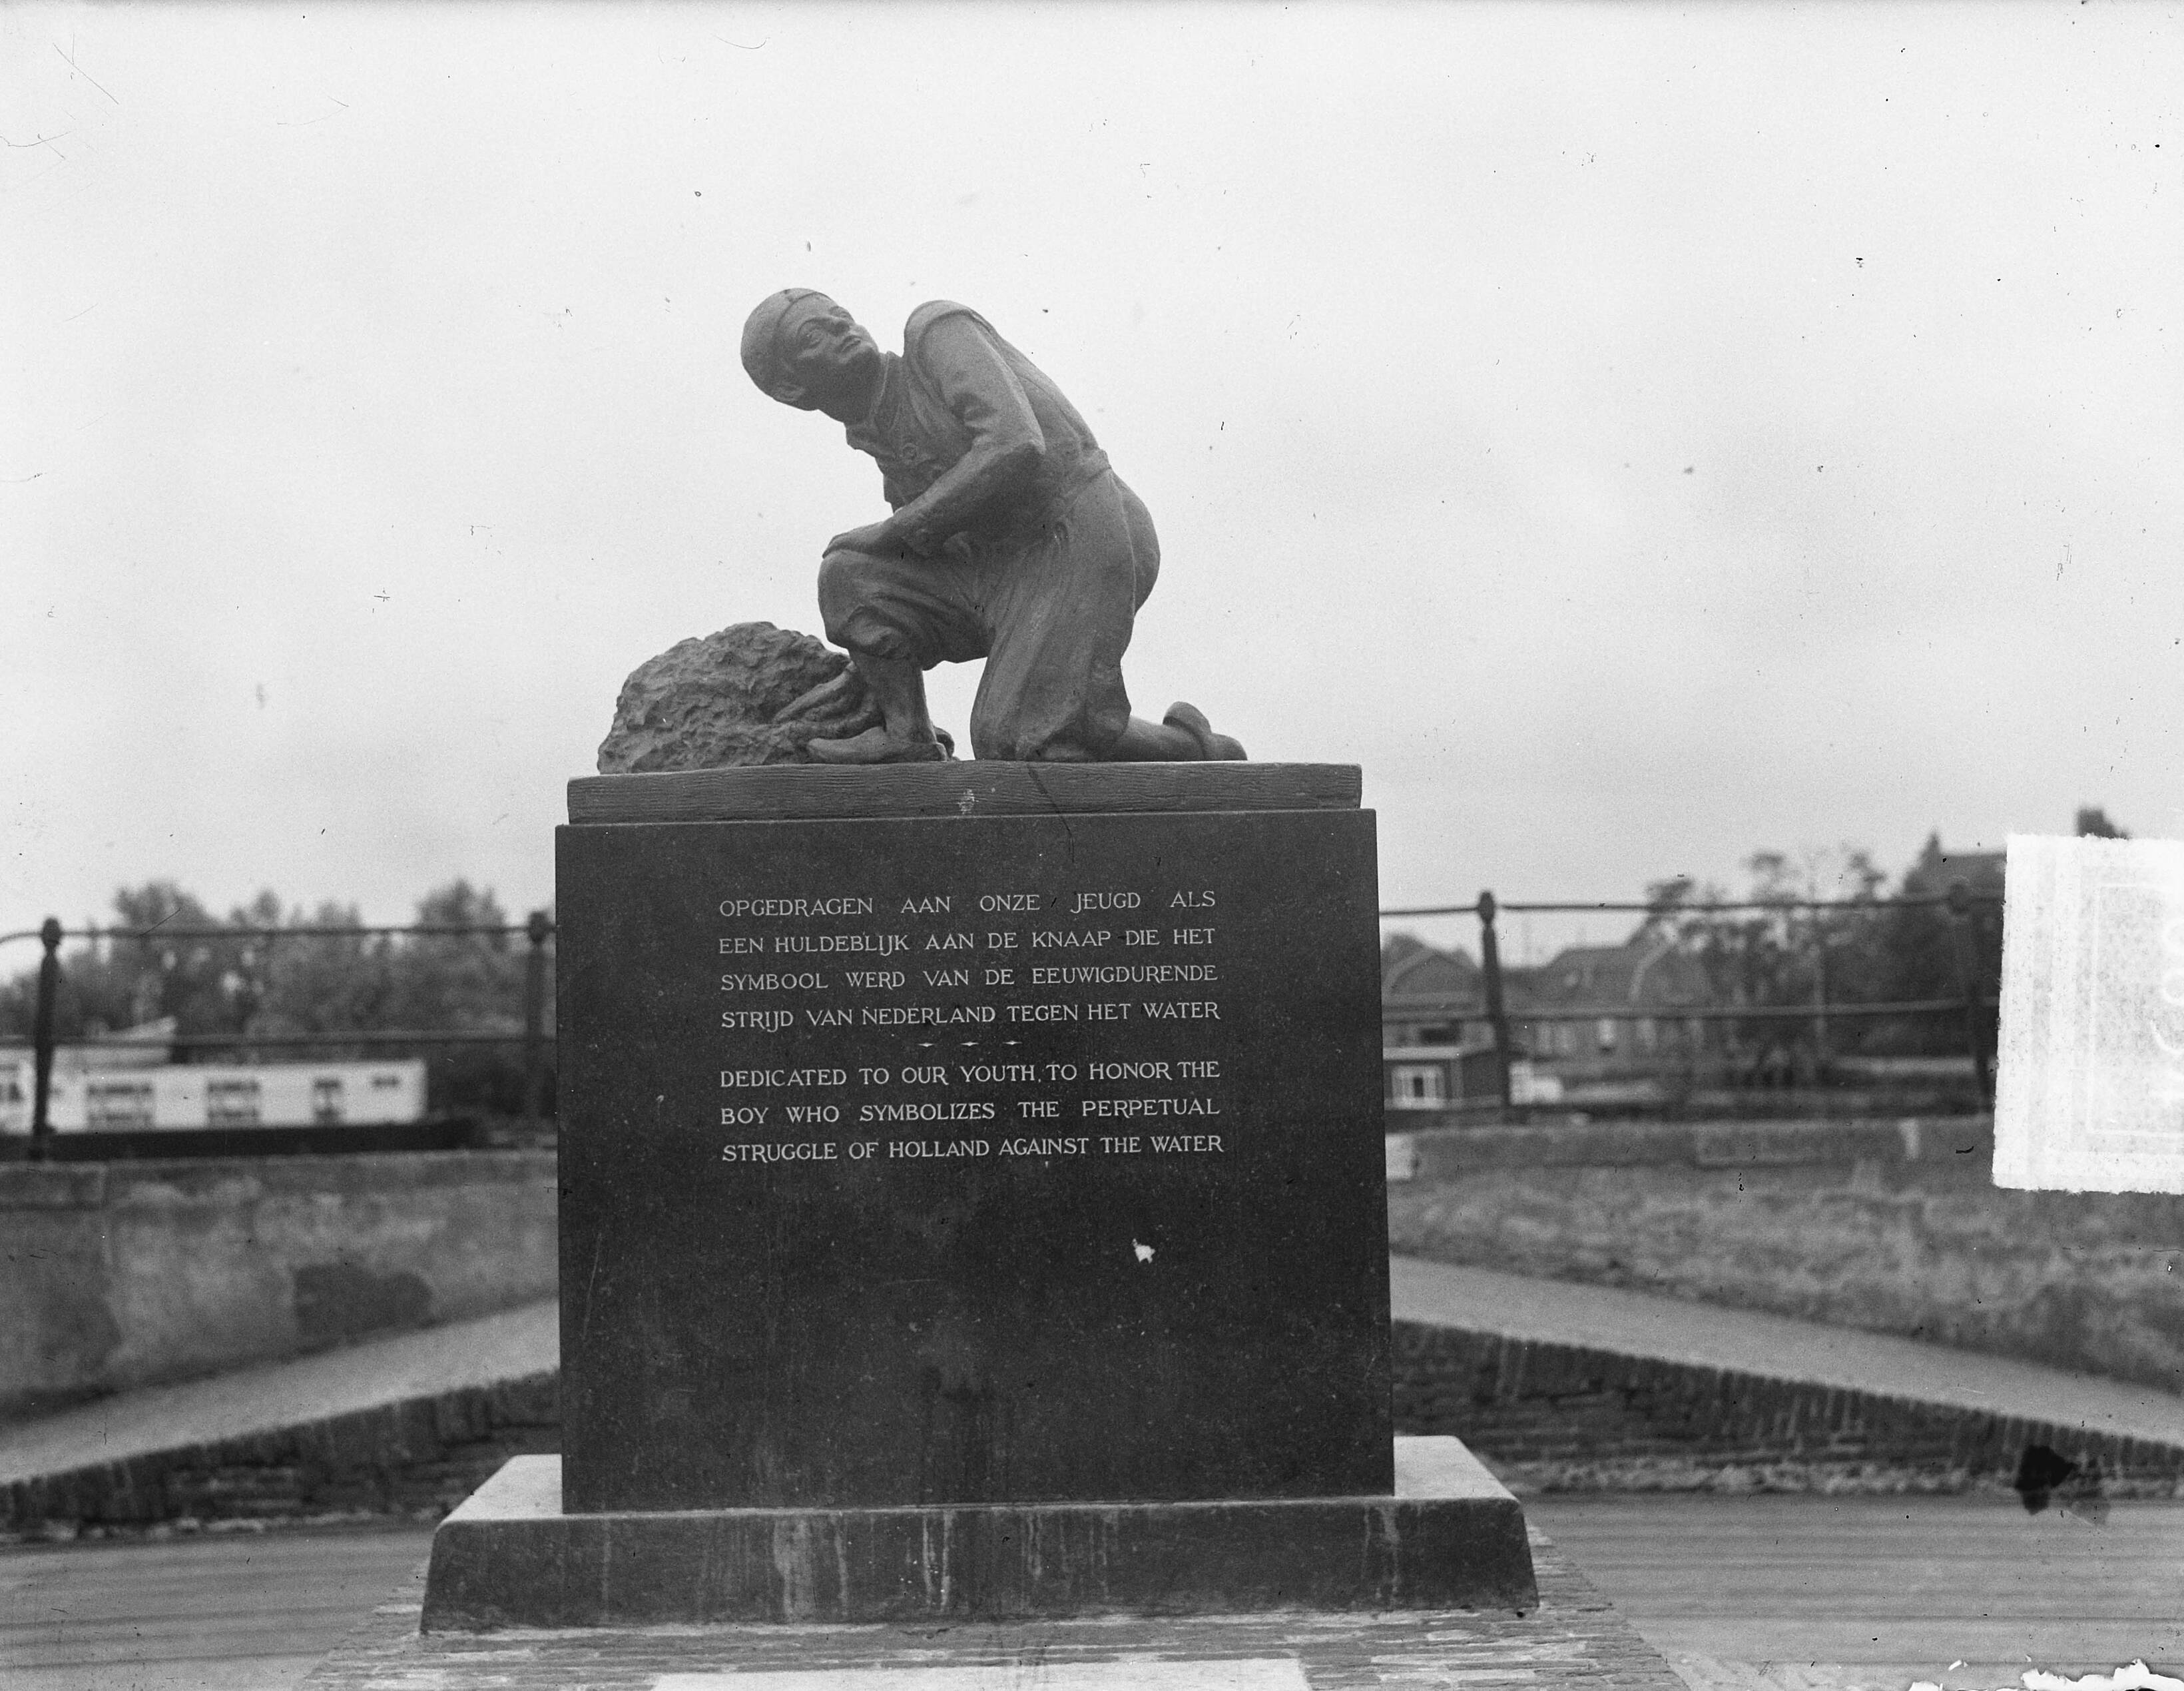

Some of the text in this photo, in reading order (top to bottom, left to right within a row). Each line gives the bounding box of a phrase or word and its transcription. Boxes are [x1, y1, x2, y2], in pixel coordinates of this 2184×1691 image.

[719, 890, 1216, 917] OPGEDRAGEN AAN ONZE JEUGD ALS
[719, 928, 1215, 956] EEN HULDEBLIJK AAN DE KNAAP DIE HET
[720, 964, 1218, 991] SYMBOOL WERD VAN DE EEUWIGDURENDE
[721, 1002, 1221, 1032] STRIJD VAN NEDERLAND TEGEN HET WATER
[720, 1069, 847, 1088] DEDICATED
[858, 1068, 890, 1085] TO
[902, 1066, 949, 1086] OUR
[1045, 1064, 1077, 1081] TO
[1089, 1062, 1173, 1081] HONOR
[1177, 1061, 1221, 1078] THE
[721, 1098, 1220, 1125] BOY WHO SYMBOLIZES THE PERPETUAL
[722, 1135, 1224, 1164] STRUGGLE OF HOLLAND AGAINST THE WATER
